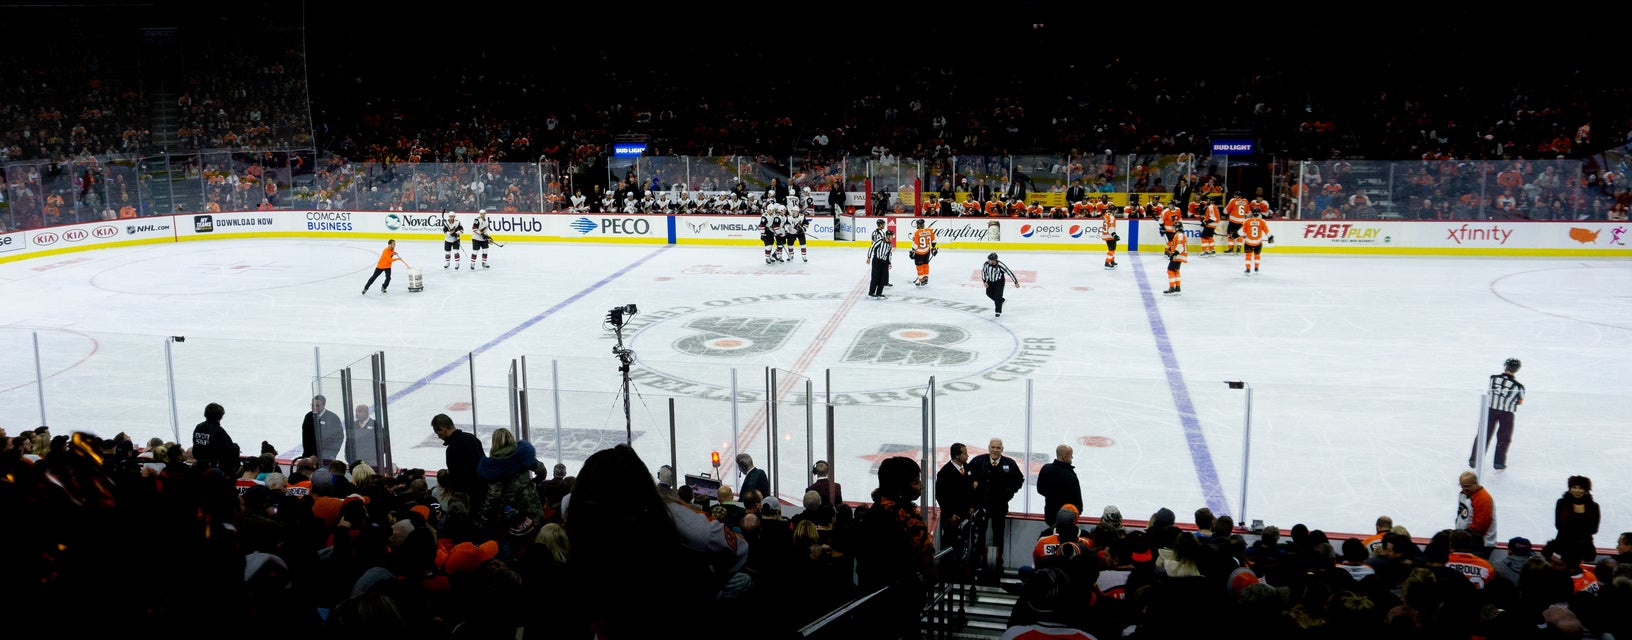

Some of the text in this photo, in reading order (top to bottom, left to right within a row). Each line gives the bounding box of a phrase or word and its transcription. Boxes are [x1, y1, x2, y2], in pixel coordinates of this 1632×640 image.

[1237, 205, 1245, 216] 6
[306, 212, 351, 221] COMCAST
[216, 217, 273, 227] DOWNLOAD NOW
[307, 222, 353, 231] BUSINESS
[487, 217, 542, 232] tubHub
[601, 218, 650, 234] PECO
[97, 228, 114, 236] KIA
[1036, 225, 1063, 235] pepsi
[1085, 225, 1103, 235] pep
[1251, 226, 1259, 238] 8
[1447, 224, 1513, 245] xfinity
[38, 235, 55, 244] KIA
[67, 231, 83, 240] KIA
